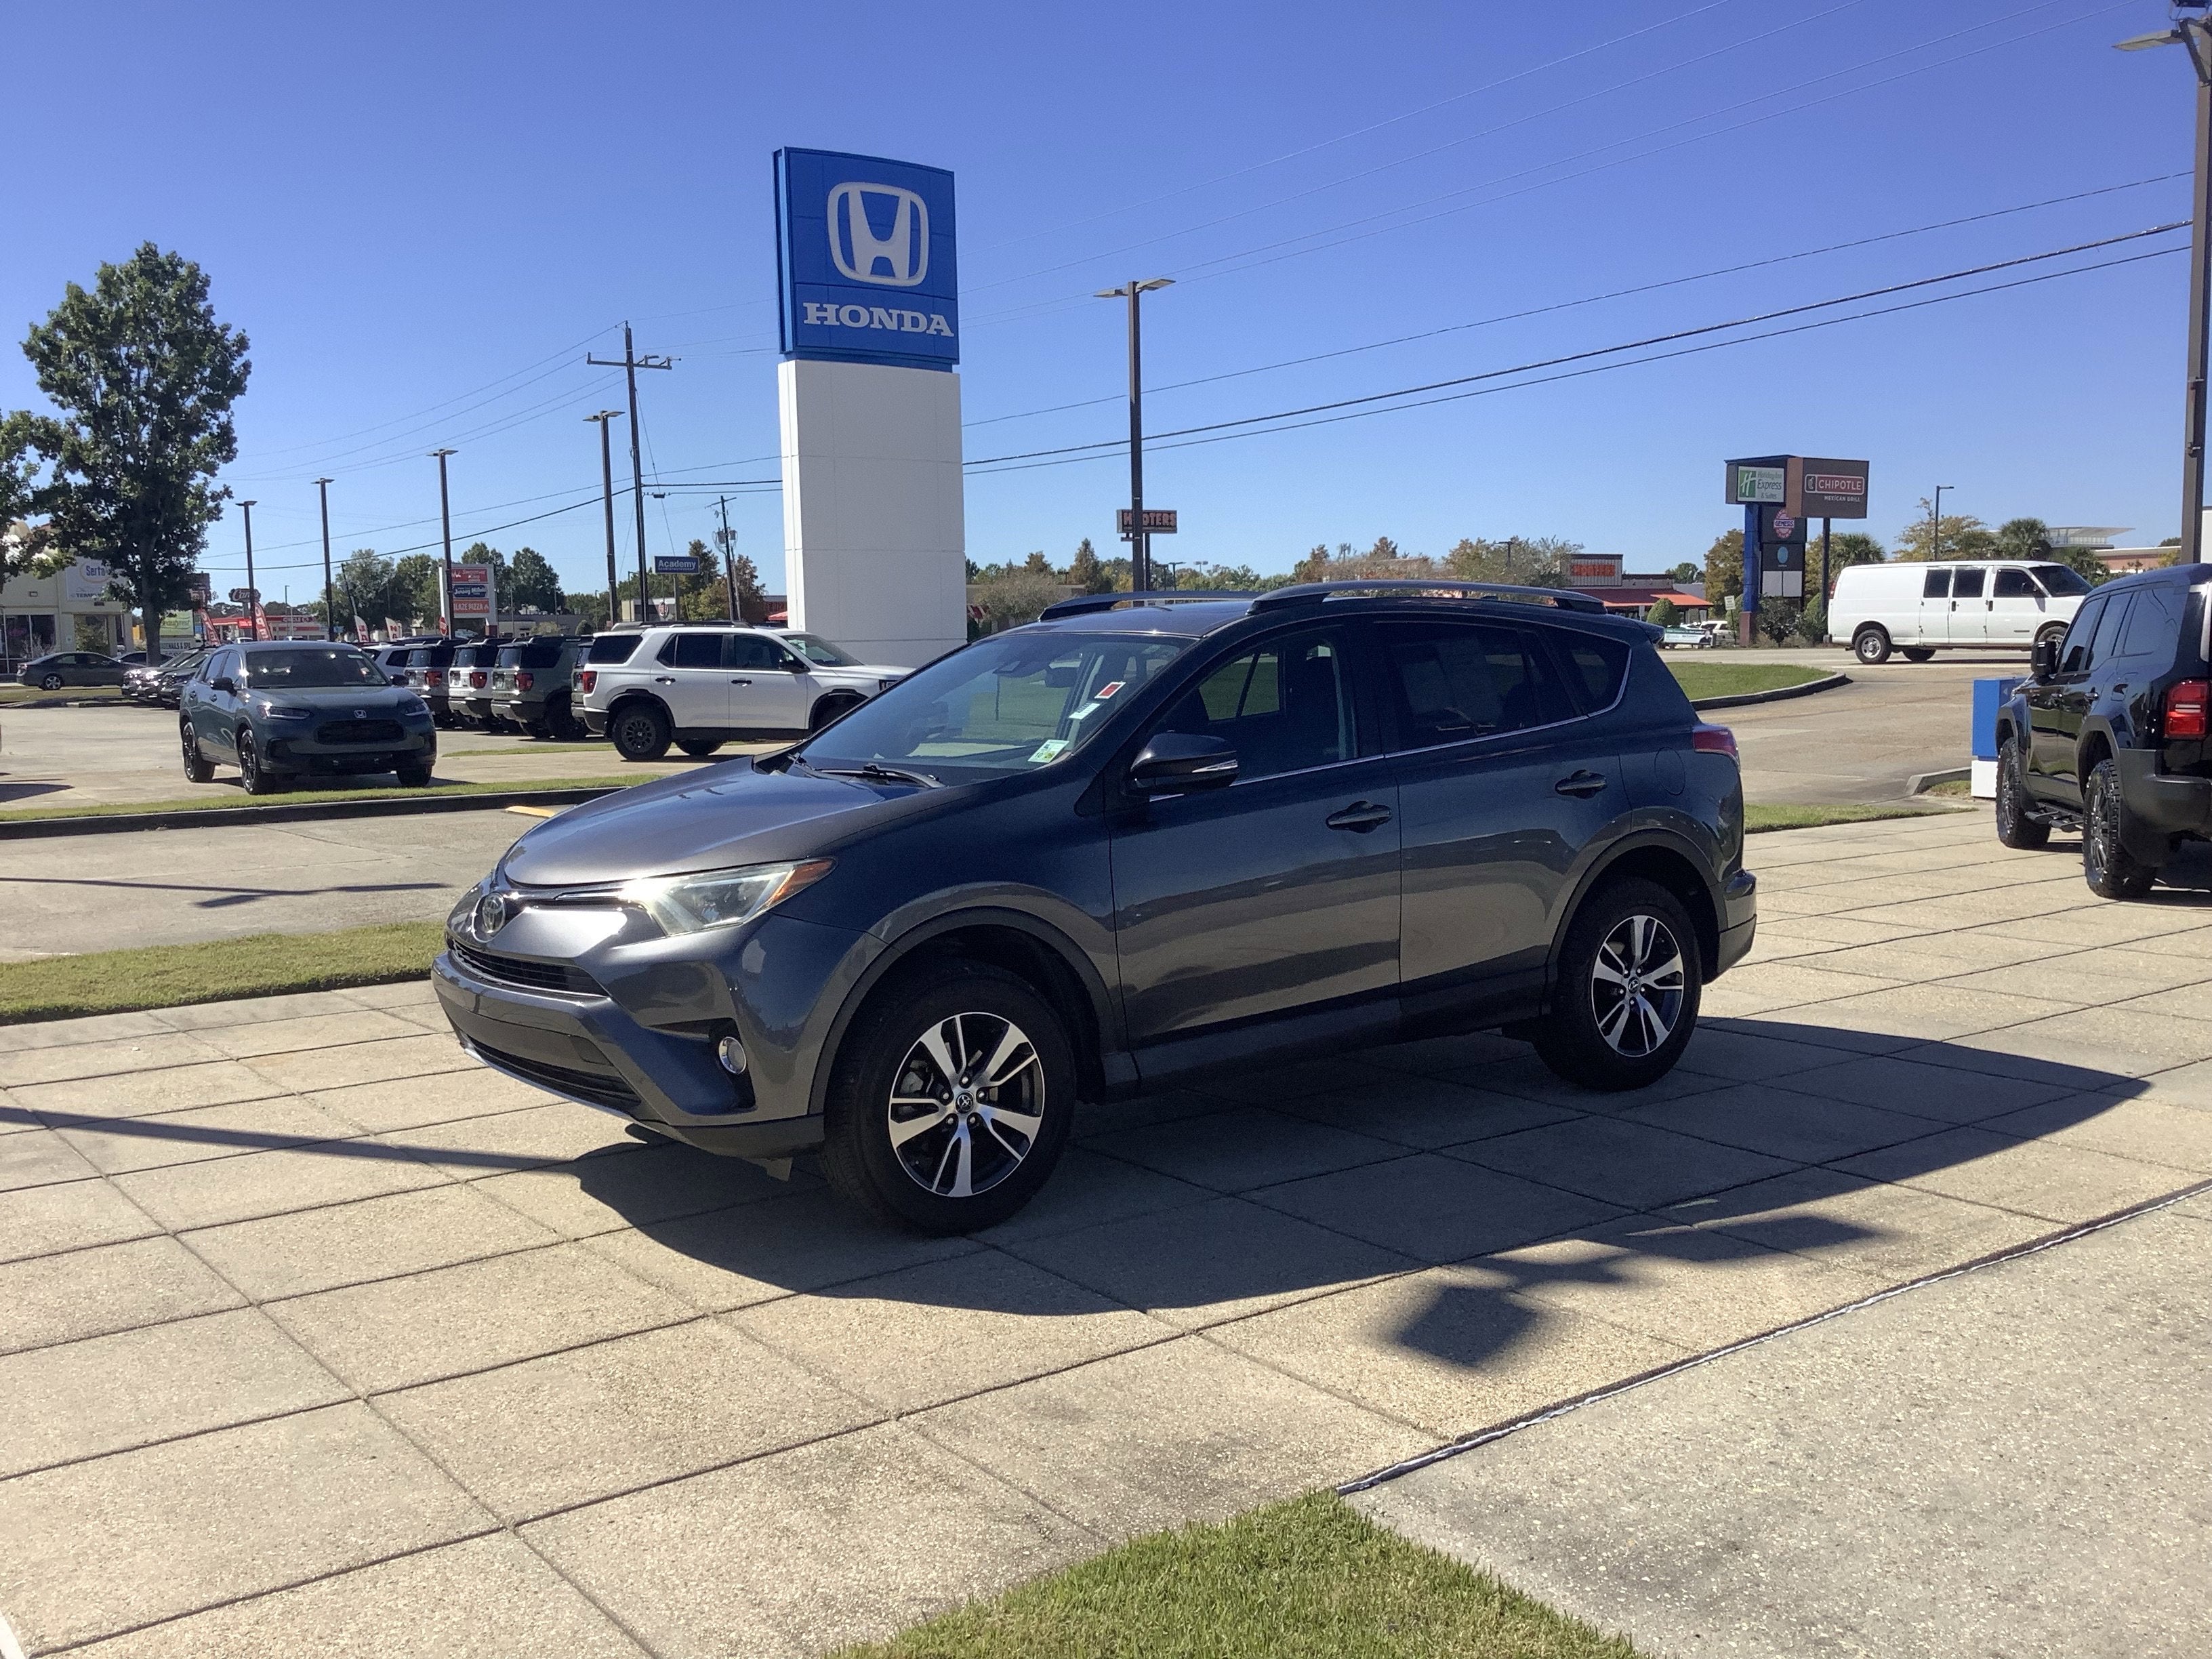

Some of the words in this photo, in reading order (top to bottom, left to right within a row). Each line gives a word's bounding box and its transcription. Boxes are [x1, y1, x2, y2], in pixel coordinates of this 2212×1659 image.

[802, 302, 955, 337] HONDA
[1757, 478, 1782, 491] Express
[1818, 479, 1862, 490] CHIPOTLE
[1123, 512, 1176, 526] HOTERS
[85, 565, 105, 576] Serta
[658, 560, 696, 570] Academy
